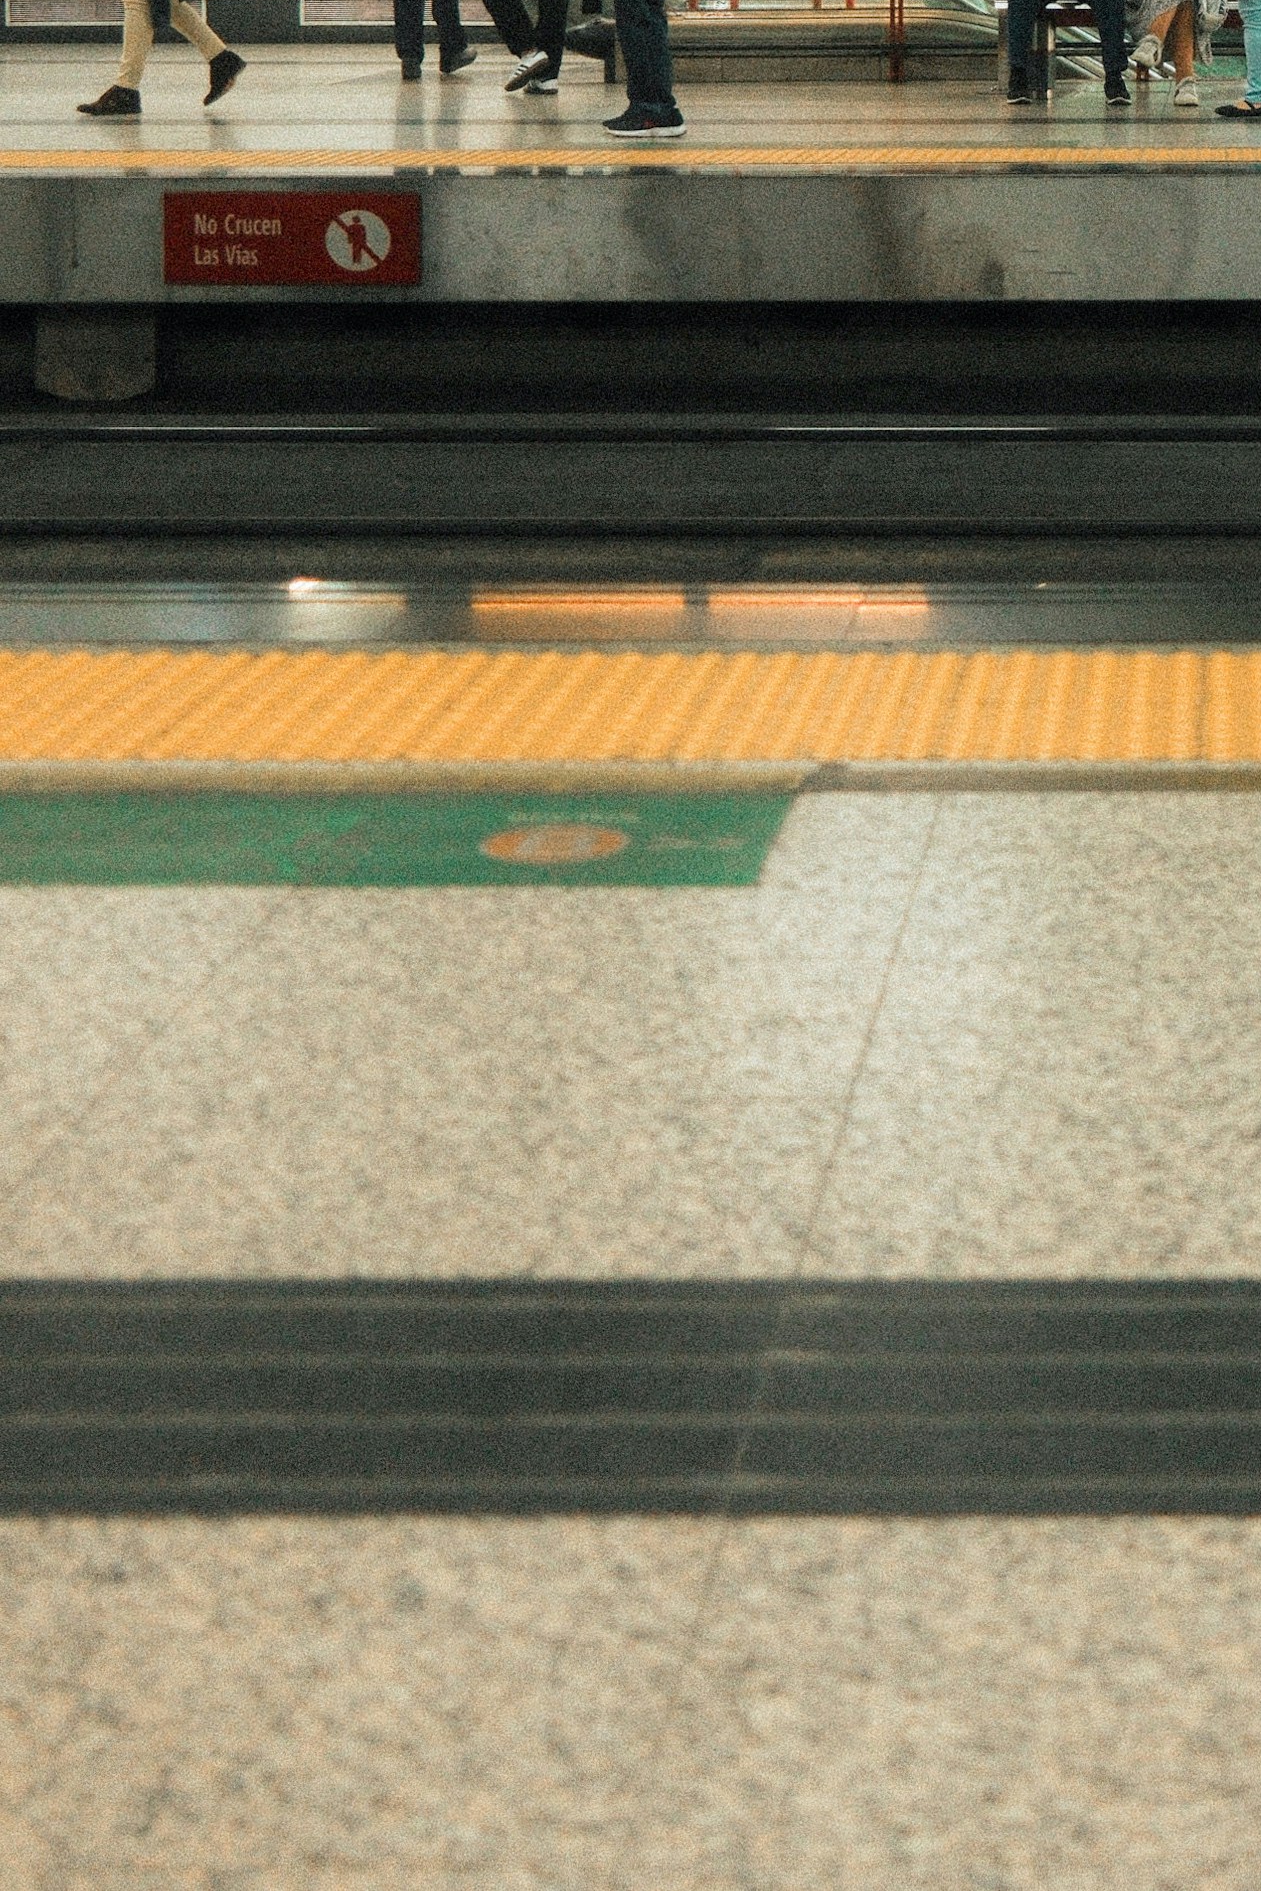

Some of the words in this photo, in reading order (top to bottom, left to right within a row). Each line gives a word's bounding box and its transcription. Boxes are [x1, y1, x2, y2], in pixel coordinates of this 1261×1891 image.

[194, 213, 219, 235] No
[224, 213, 282, 236] Crucen
[194, 244, 220, 265] Las
